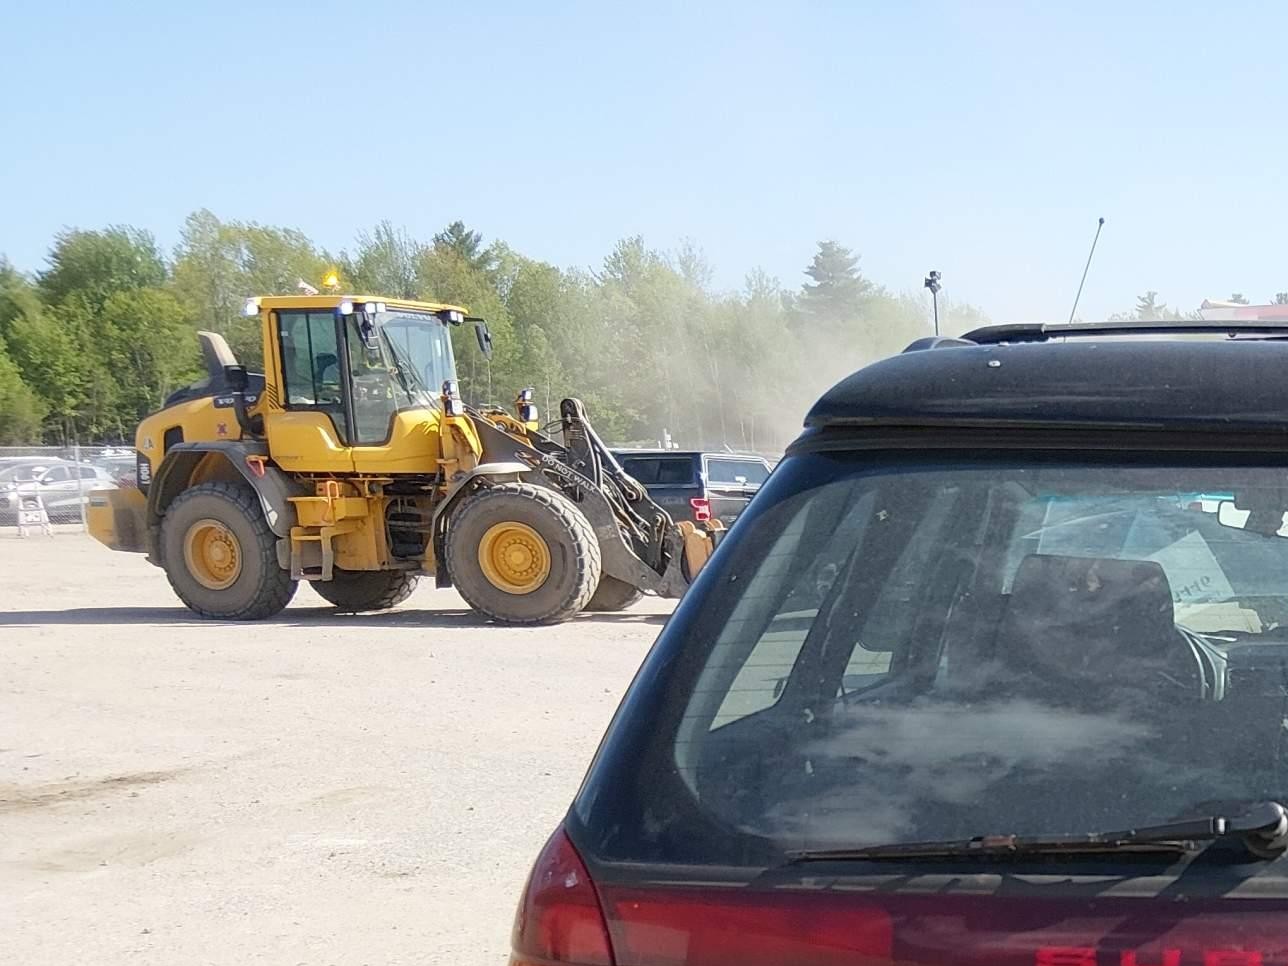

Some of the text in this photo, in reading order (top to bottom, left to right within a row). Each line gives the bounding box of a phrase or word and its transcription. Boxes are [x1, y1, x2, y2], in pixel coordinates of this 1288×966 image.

[542, 455, 596, 492] DO NOT WALK
